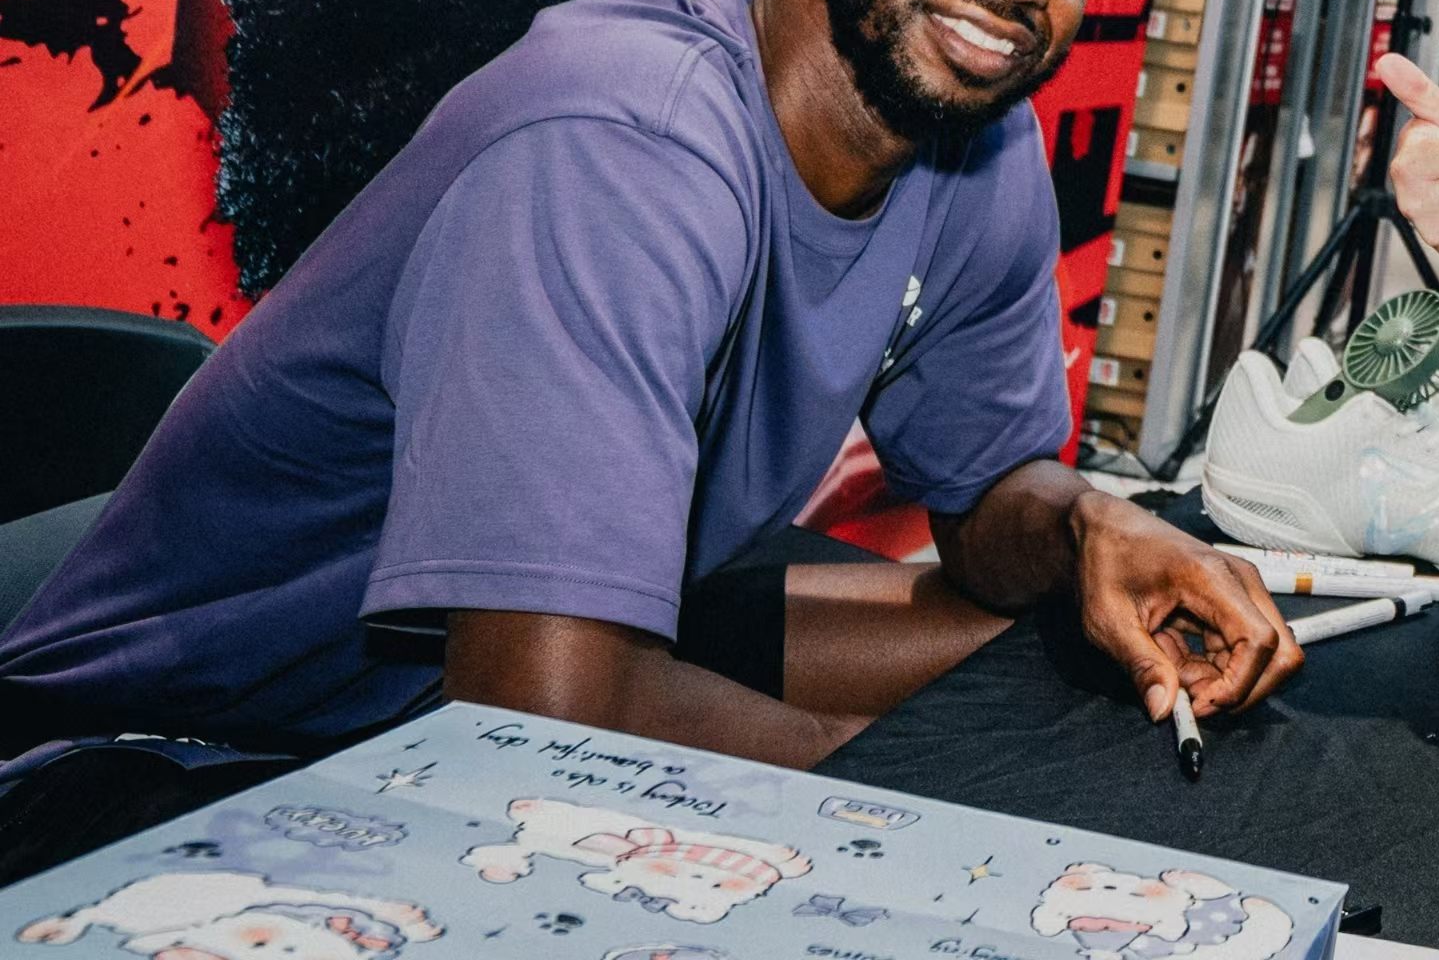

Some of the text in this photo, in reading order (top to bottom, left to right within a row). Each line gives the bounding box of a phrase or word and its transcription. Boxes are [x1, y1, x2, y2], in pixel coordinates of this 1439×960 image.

[537, 737, 655, 775] beautiful
[662, 765, 687, 775] a
[551, 768, 728, 818] Today is also
